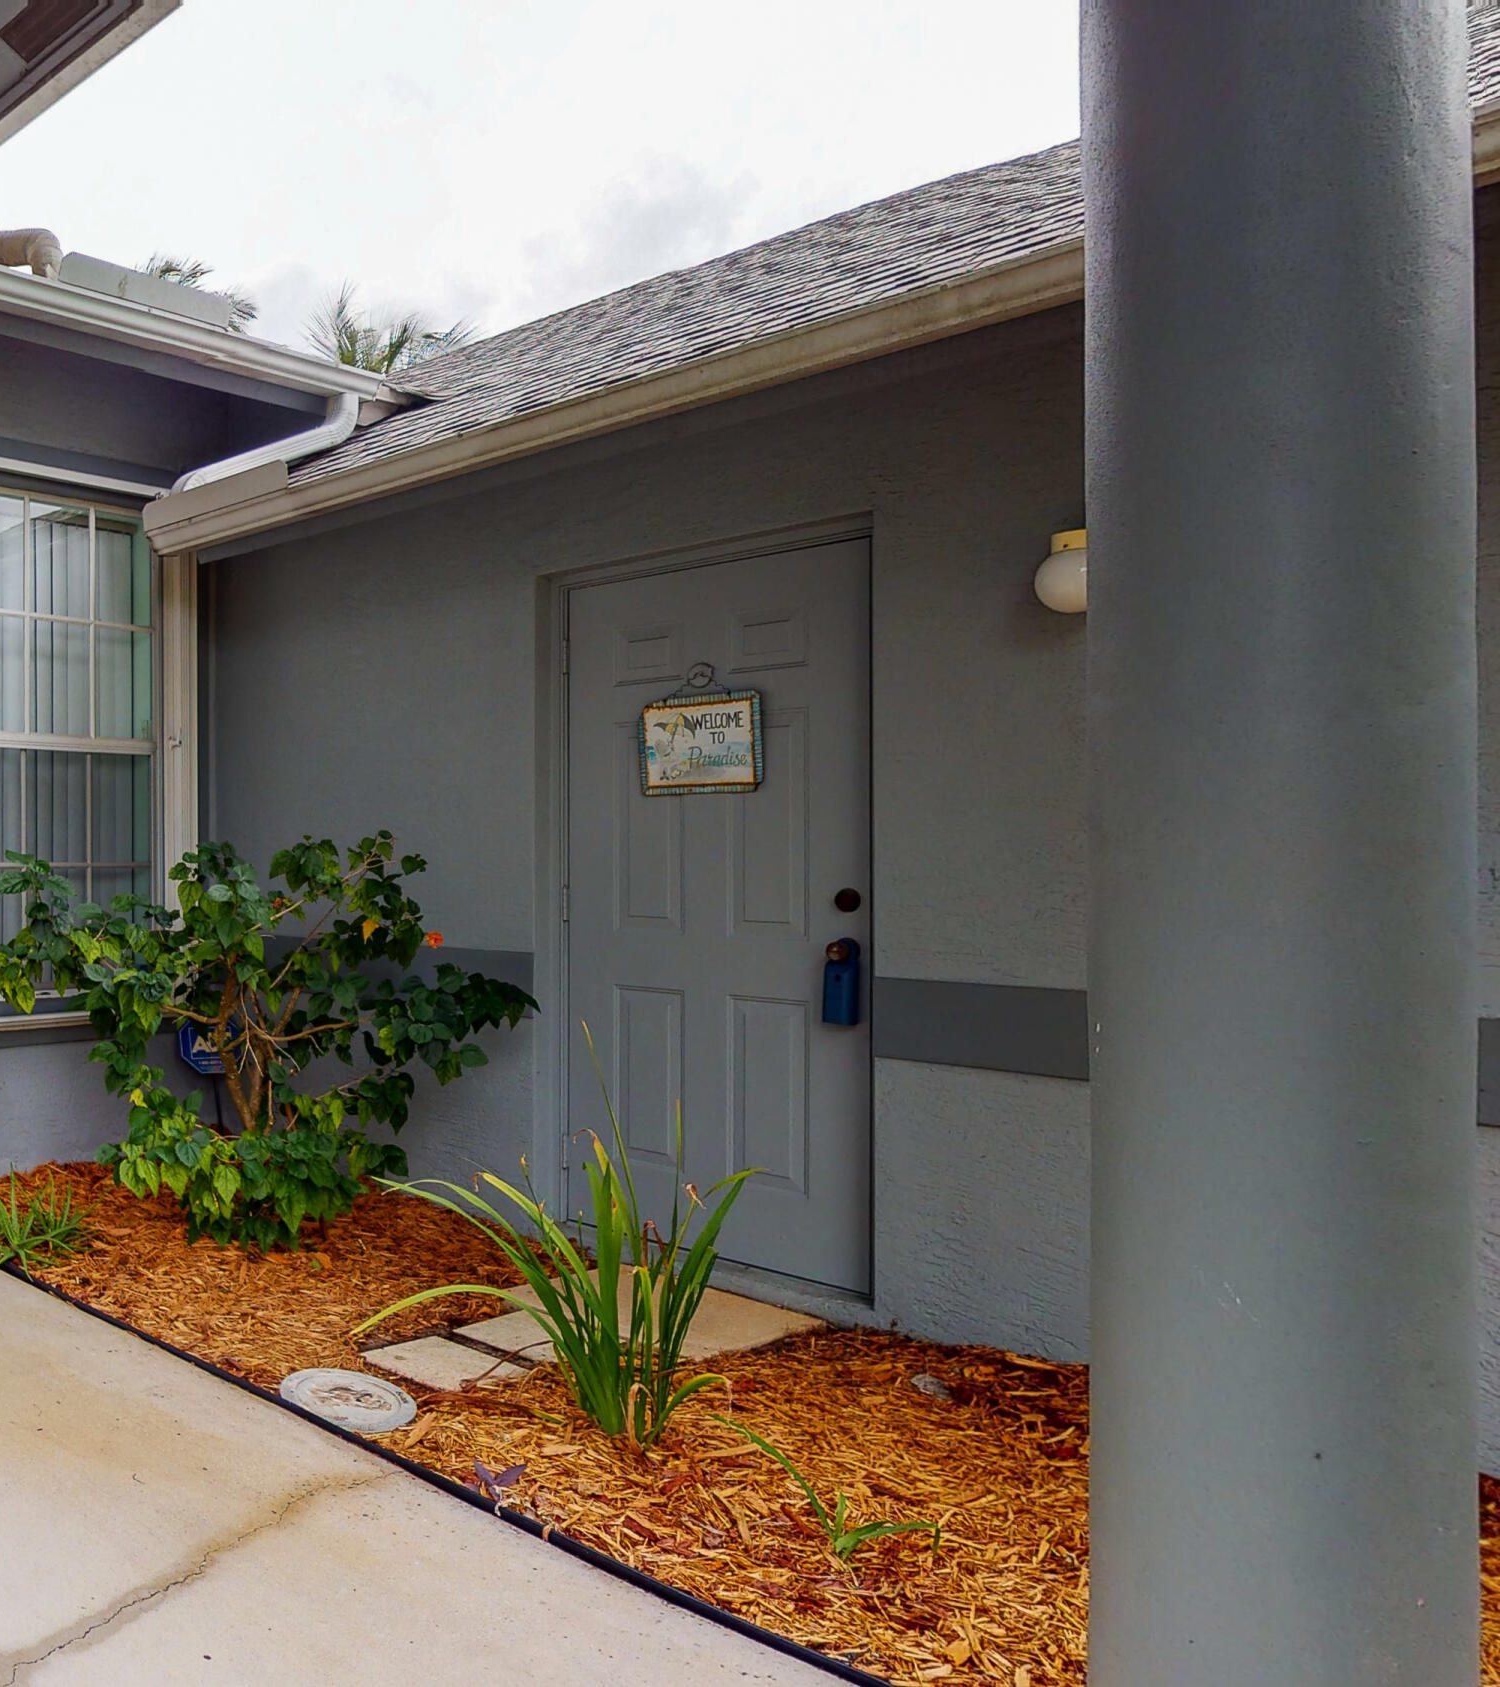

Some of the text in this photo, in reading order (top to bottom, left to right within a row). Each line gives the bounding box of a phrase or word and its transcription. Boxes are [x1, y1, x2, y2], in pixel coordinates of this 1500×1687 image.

[690, 710, 745, 730] WELCOME
[709, 730, 726, 744] TO
[687, 745, 748, 770] Paradise
